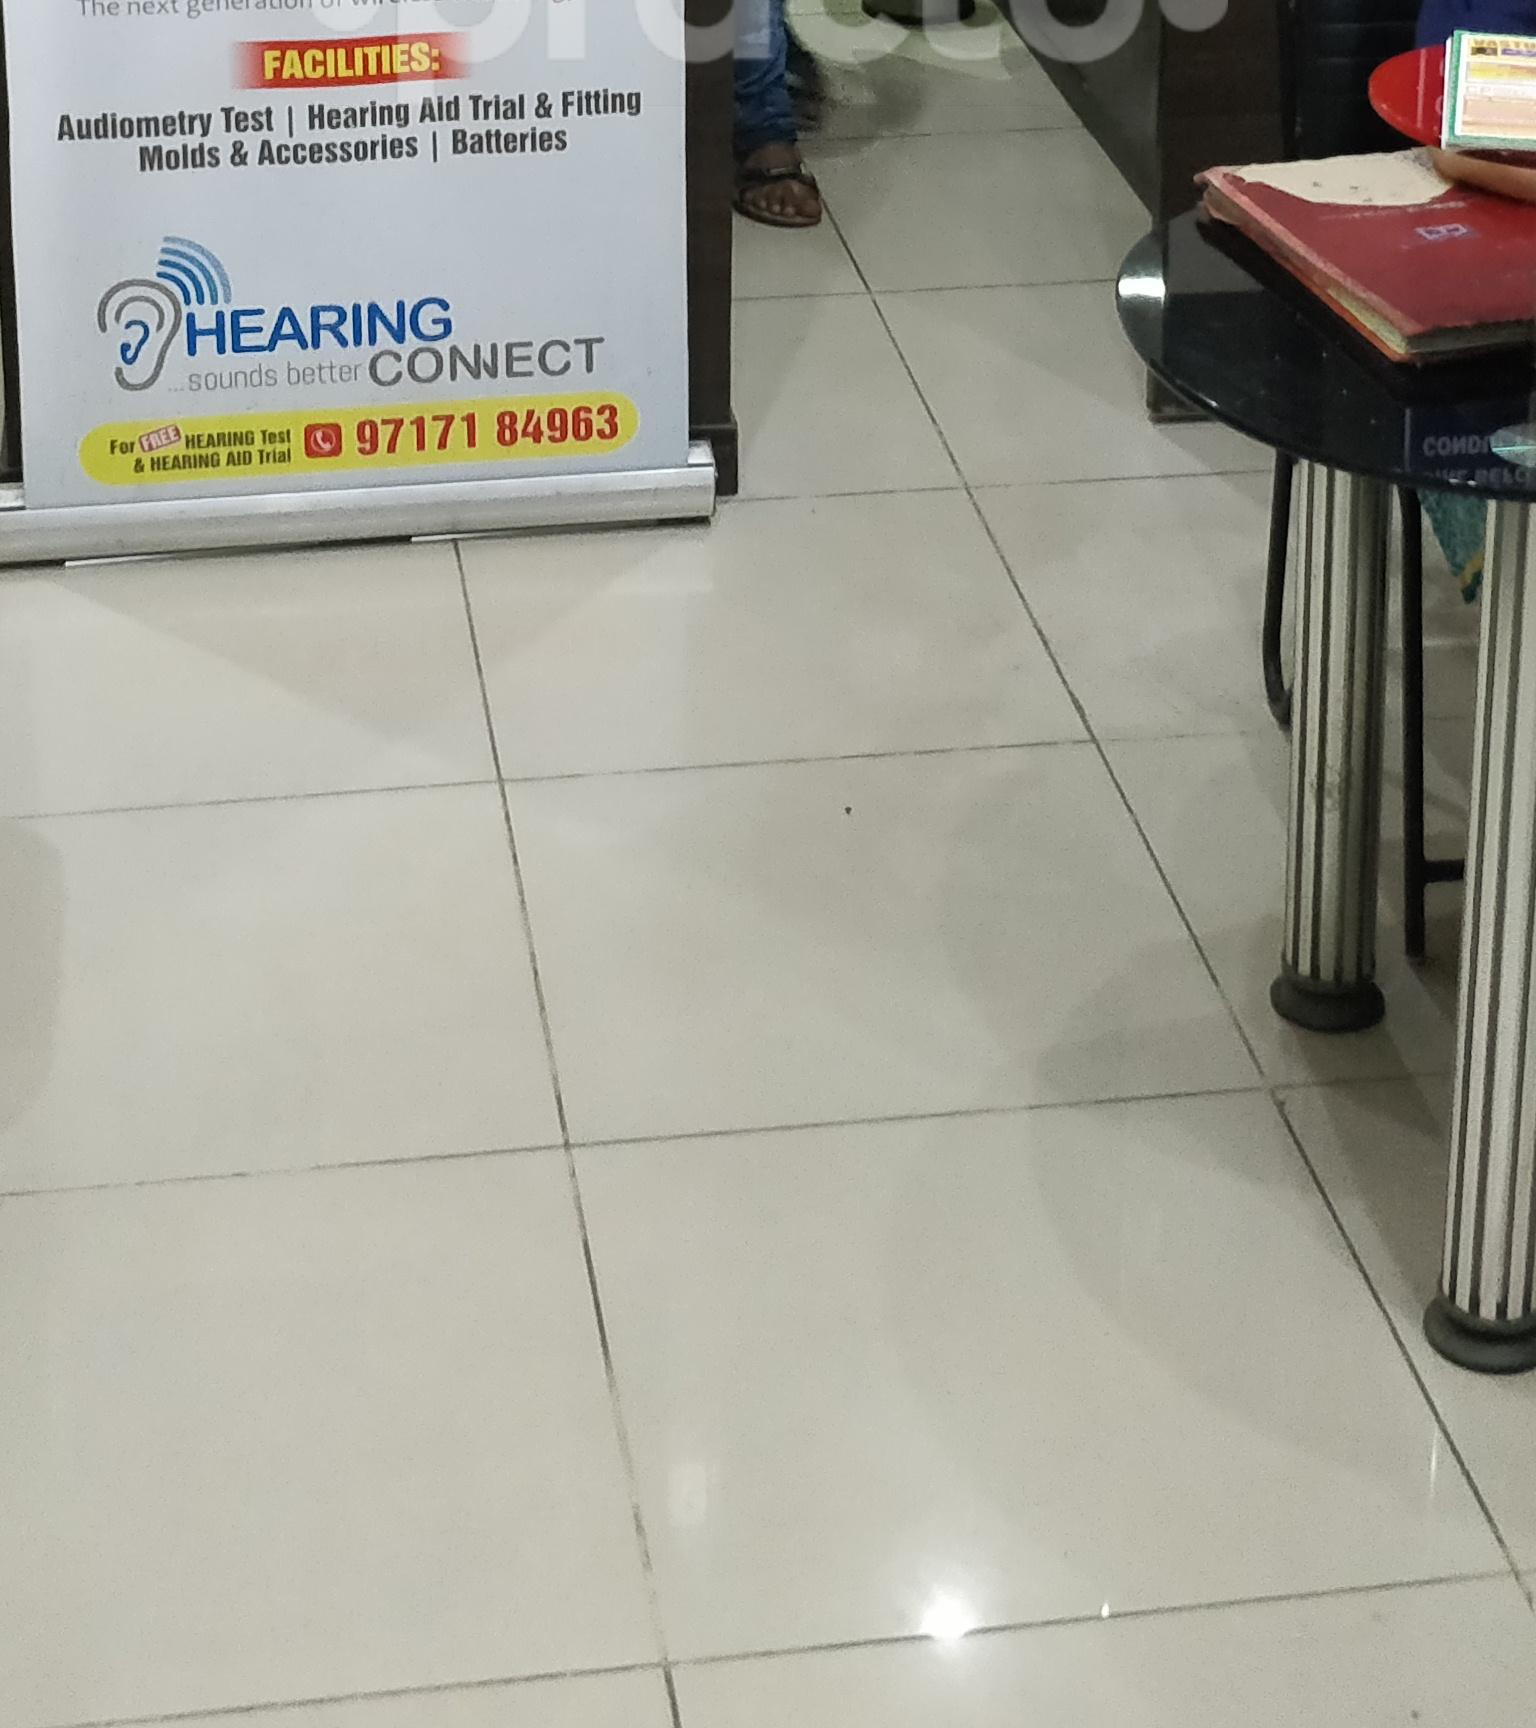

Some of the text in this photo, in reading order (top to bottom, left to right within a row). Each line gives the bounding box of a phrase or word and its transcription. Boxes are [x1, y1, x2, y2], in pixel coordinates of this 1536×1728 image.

[263, 41, 441, 81] FACILITIES:
[57, 110, 212, 142] Audiometry
[220, 106, 275, 135] Test
[307, 99, 411, 132] Hearing
[419, 96, 461, 124] Aid
[468, 93, 525, 121] Trial
[535, 93, 554, 119] &
[562, 87, 642, 119] Fitting
[138, 142, 220, 174] Molds
[229, 141, 250, 167] &
[257, 134, 419, 167] Accessories
[451, 126, 568, 157] Batteries
[185, 297, 453, 358] HEARING
[286, 360, 363, 387] better
[110, 428, 291, 455] For FREE HEARING Test
[356, 403, 619, 457] 97171 84963
[133, 448, 291, 473] & HEARING AID Trial
